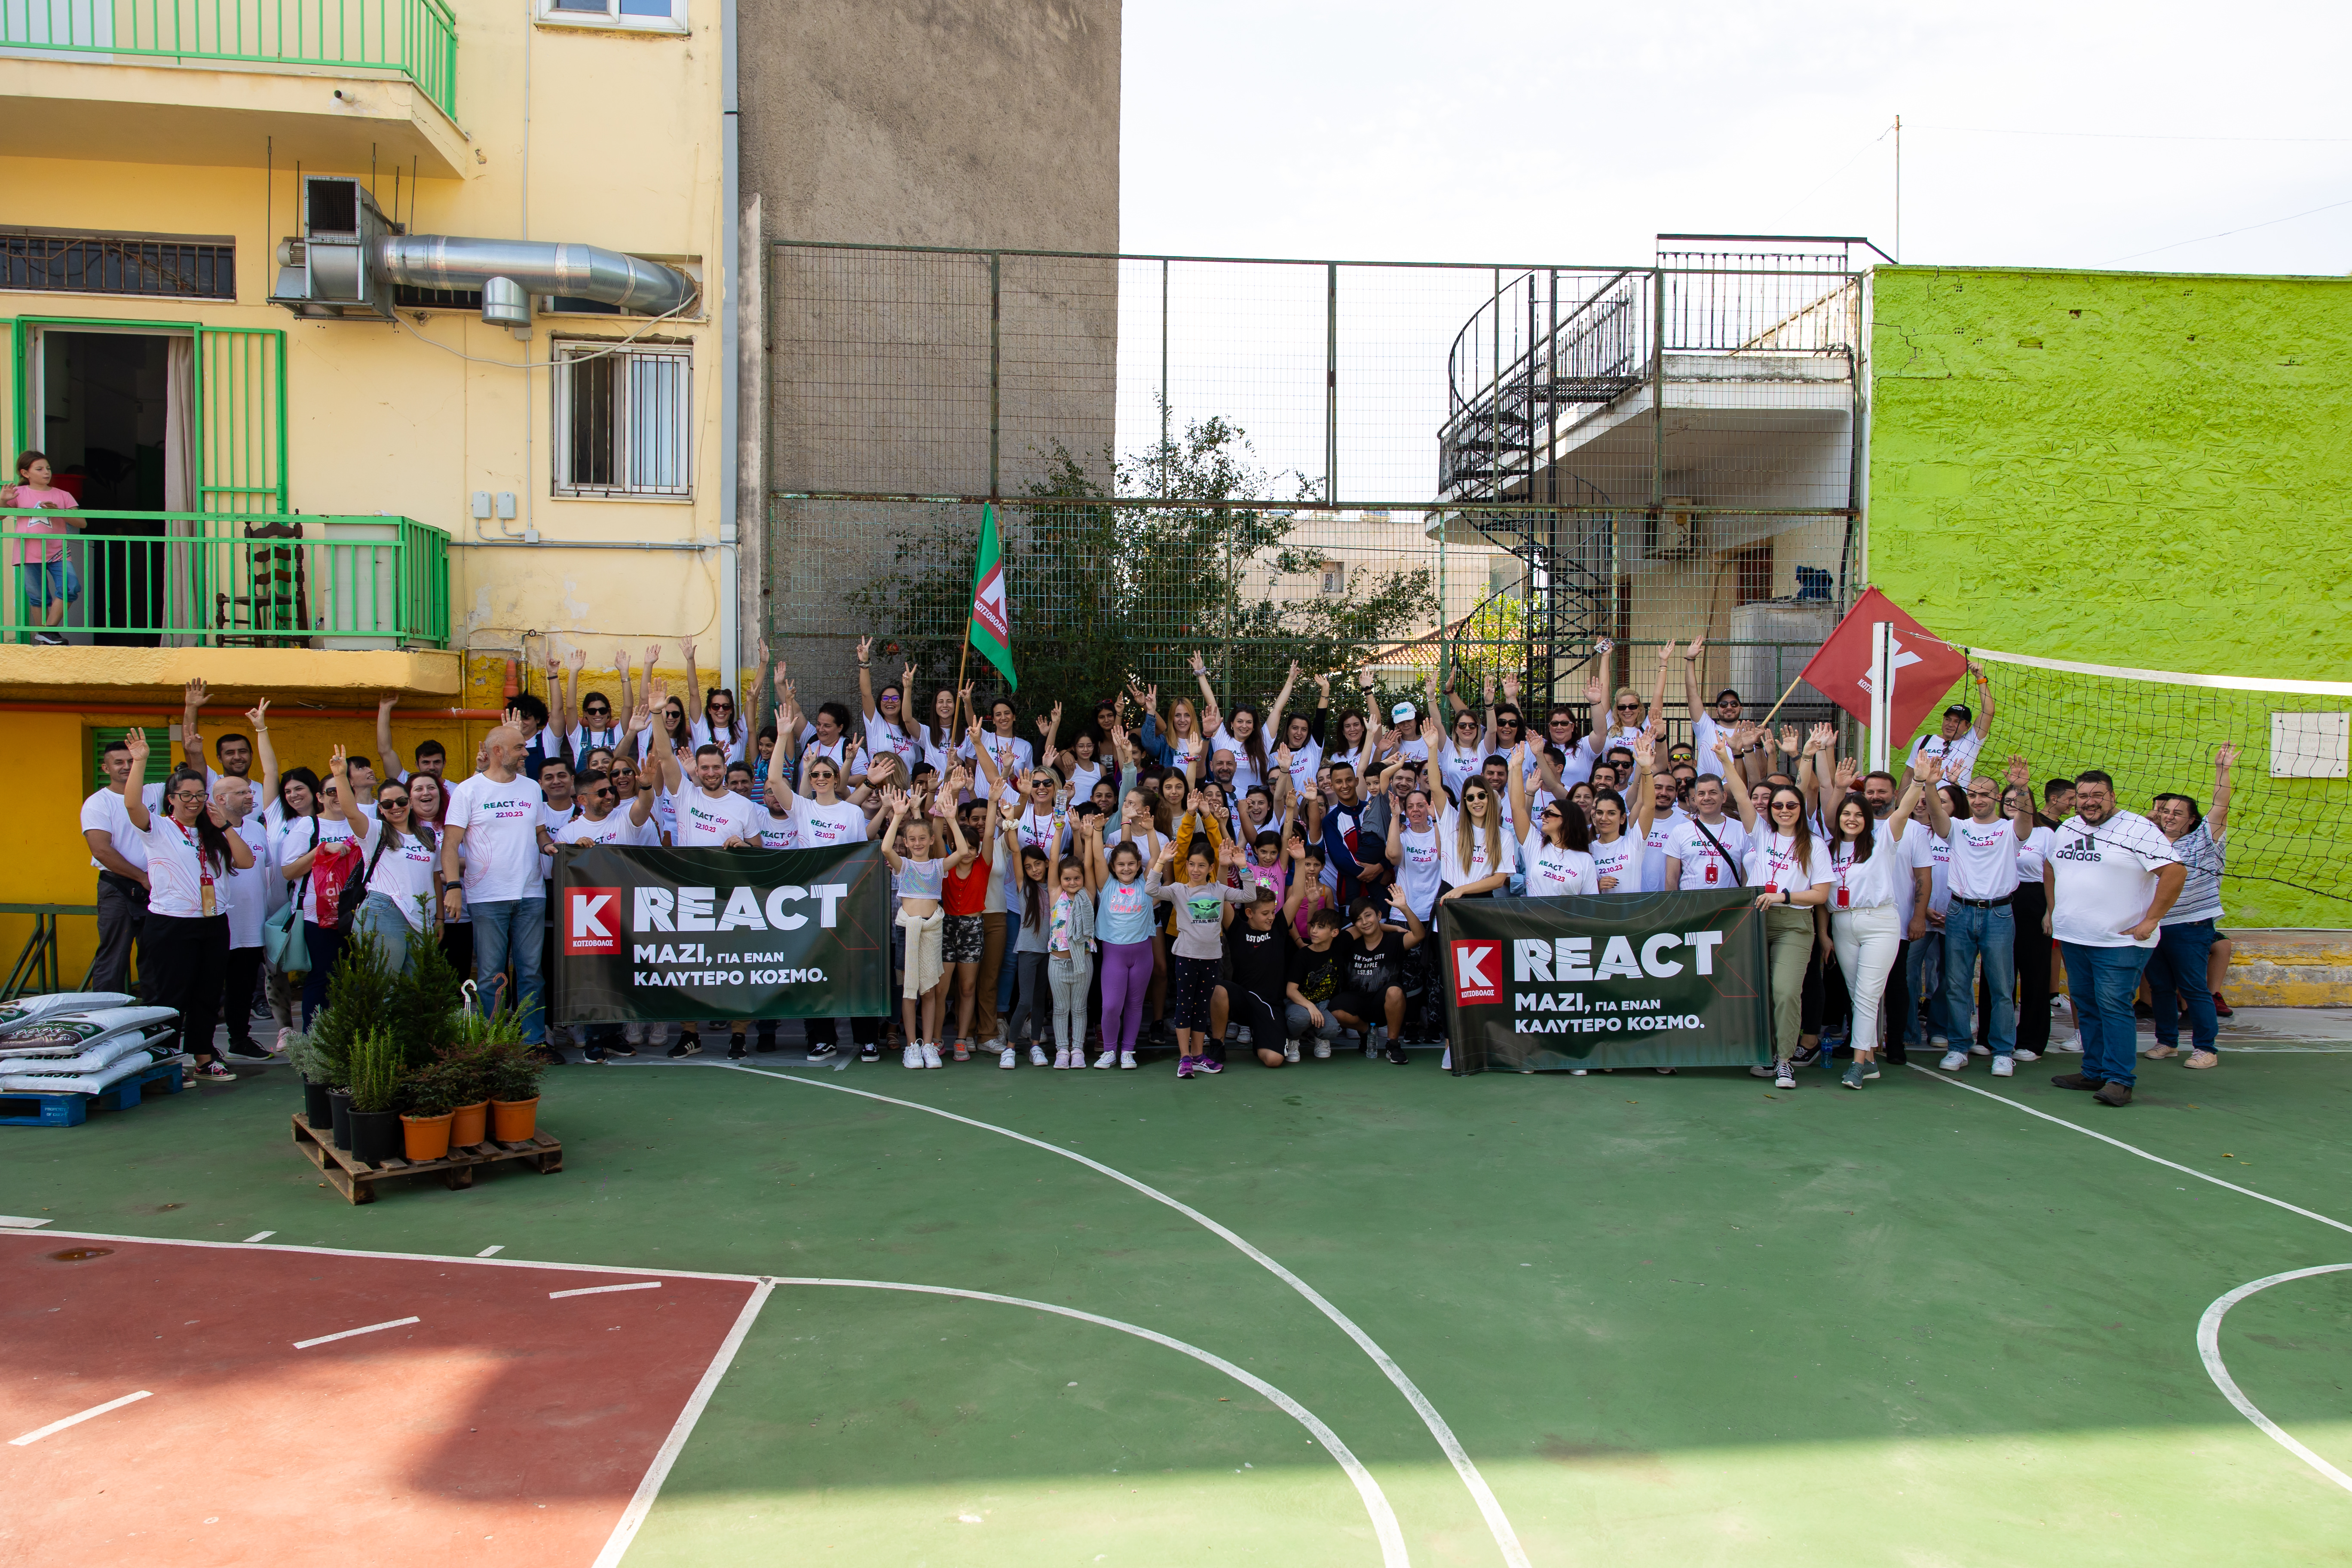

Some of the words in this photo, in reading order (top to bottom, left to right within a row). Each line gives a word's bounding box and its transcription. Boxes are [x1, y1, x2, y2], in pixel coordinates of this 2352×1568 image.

[974, 600, 1007, 636] ΚΩΤΣΟΒΟΛΟΣ
[484, 800, 515, 809] REACT
[518, 800, 532, 808] day
[690, 807, 714, 821] REACT
[716, 817, 729, 825] day
[695, 822, 717, 833] 22.10.23
[811, 819, 832, 828] REACT
[834, 823, 847, 831] day
[760, 830, 785, 839] REACT
[815, 830, 835, 839] 22.10.23
[253, 844, 263, 852] day
[1406, 846, 1427, 855] REACT
[406, 853, 430, 862] 22.10.23
[1595, 857, 1615, 865] EACT
[2056, 849, 2101, 862] adidas
[1539, 860, 1563, 871] REACT
[1565, 868, 1578, 877] day
[1598, 864, 1623, 874] 22.10.23
[1543, 871, 1565, 882] 22.10.23
[634, 883, 848, 932] REACT
[1110, 904, 1142, 913] TOMATO
[1257, 934, 1265, 943] DO
[634, 943, 713, 966] ΜΑΖΙ,
[717, 953, 740, 963] ΓΙΑ
[744, 952, 784, 962] ΕΝΑΝ
[1514, 931, 1723, 981] REACT
[634, 970, 744, 986] ΚΑΛΥΤΕΡΟ
[750, 968, 828, 984] ΚΟΣΜΟ.
[1461, 989, 1494, 998] ΚΩΤΣΟΒΟΛΟΣ
[1515, 993, 1591, 1014] ΜΑΖΙ,
[1596, 1001, 1617, 1011] ΓΙΑ
[1621, 999, 1660, 1010] ΕΝΑΝ
[1516, 1017, 1622, 1033] ΚΑΛΥΤΕΡΟ
[1627, 1014, 1705, 1030] ΚΟΣΜΟ.
